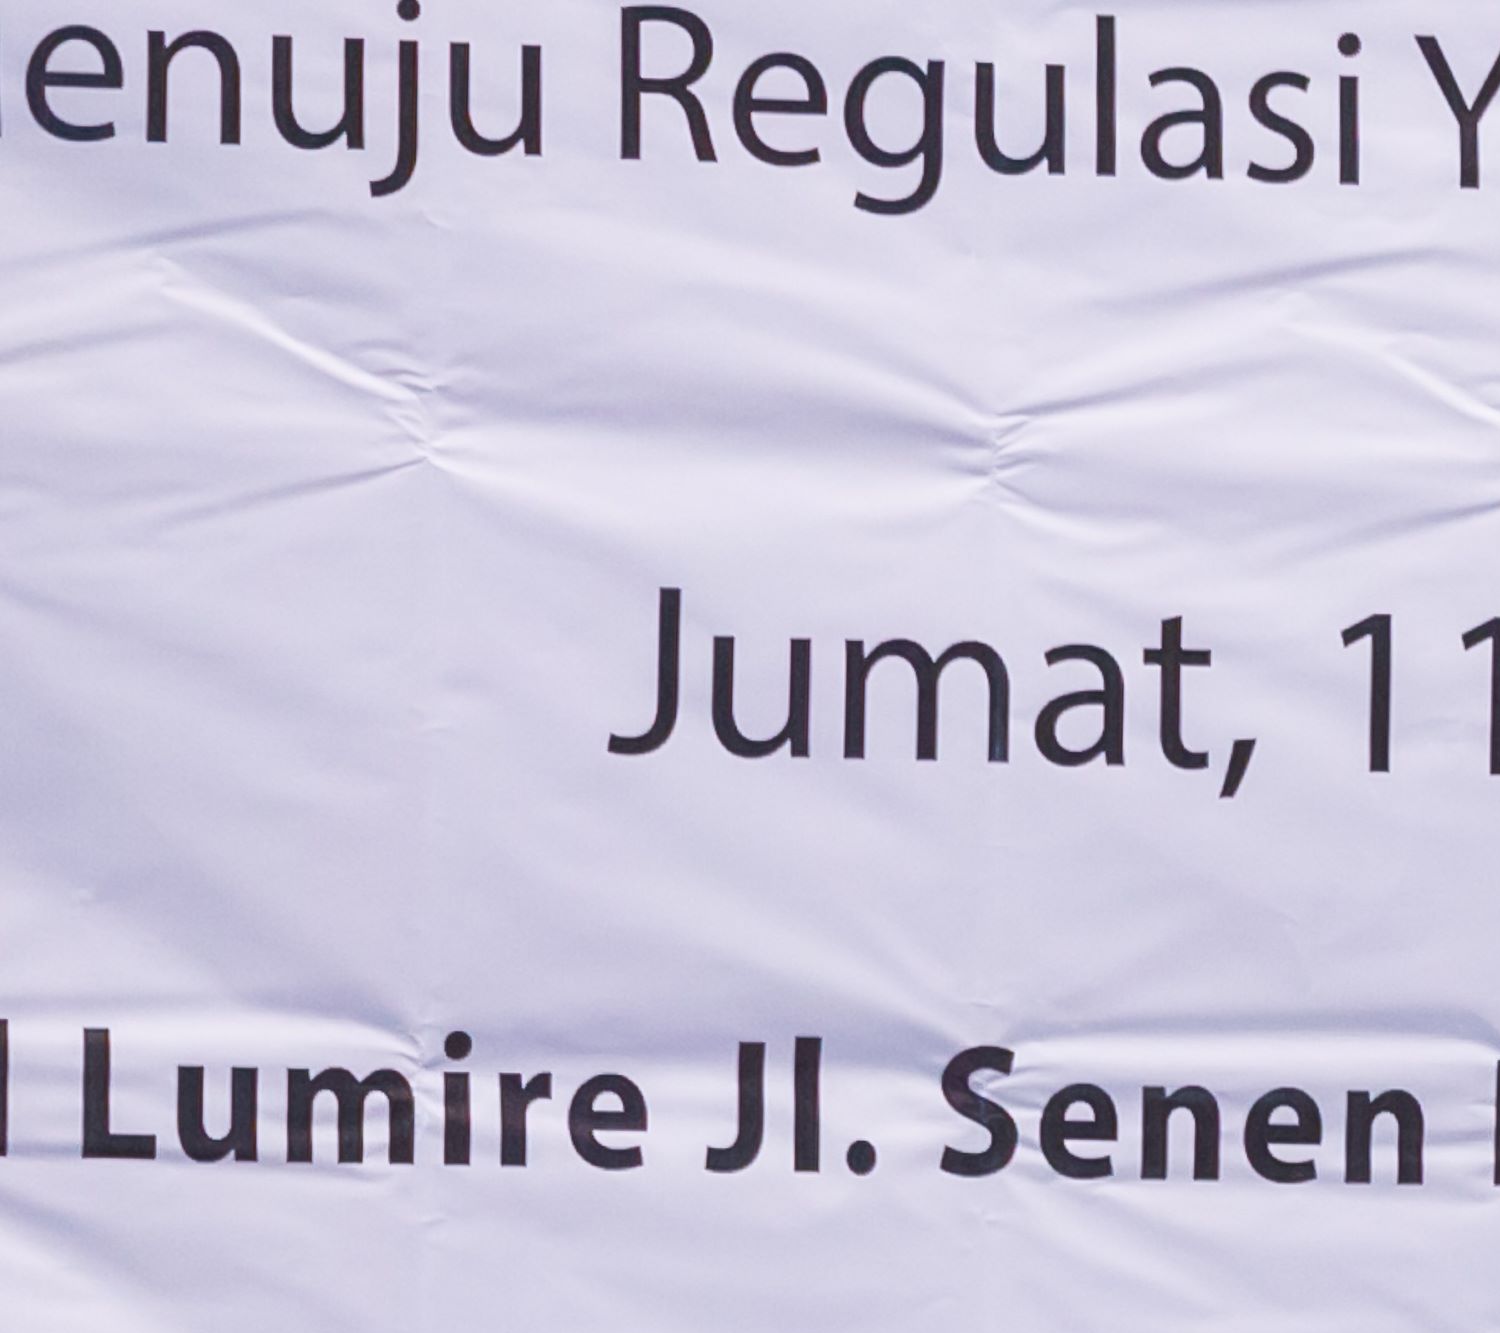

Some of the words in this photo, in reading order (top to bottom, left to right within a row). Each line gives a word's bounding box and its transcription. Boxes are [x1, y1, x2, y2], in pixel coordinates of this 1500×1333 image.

[0, 0, 542, 197] enuju
[621, 5, 1361, 215] Regulasi
[607, 587, 1256, 798] Jumat,
[81, 1028, 647, 1170] Lumire
[705, 1036, 876, 1175] Jl.
[940, 1045, 1424, 1185] Senen
